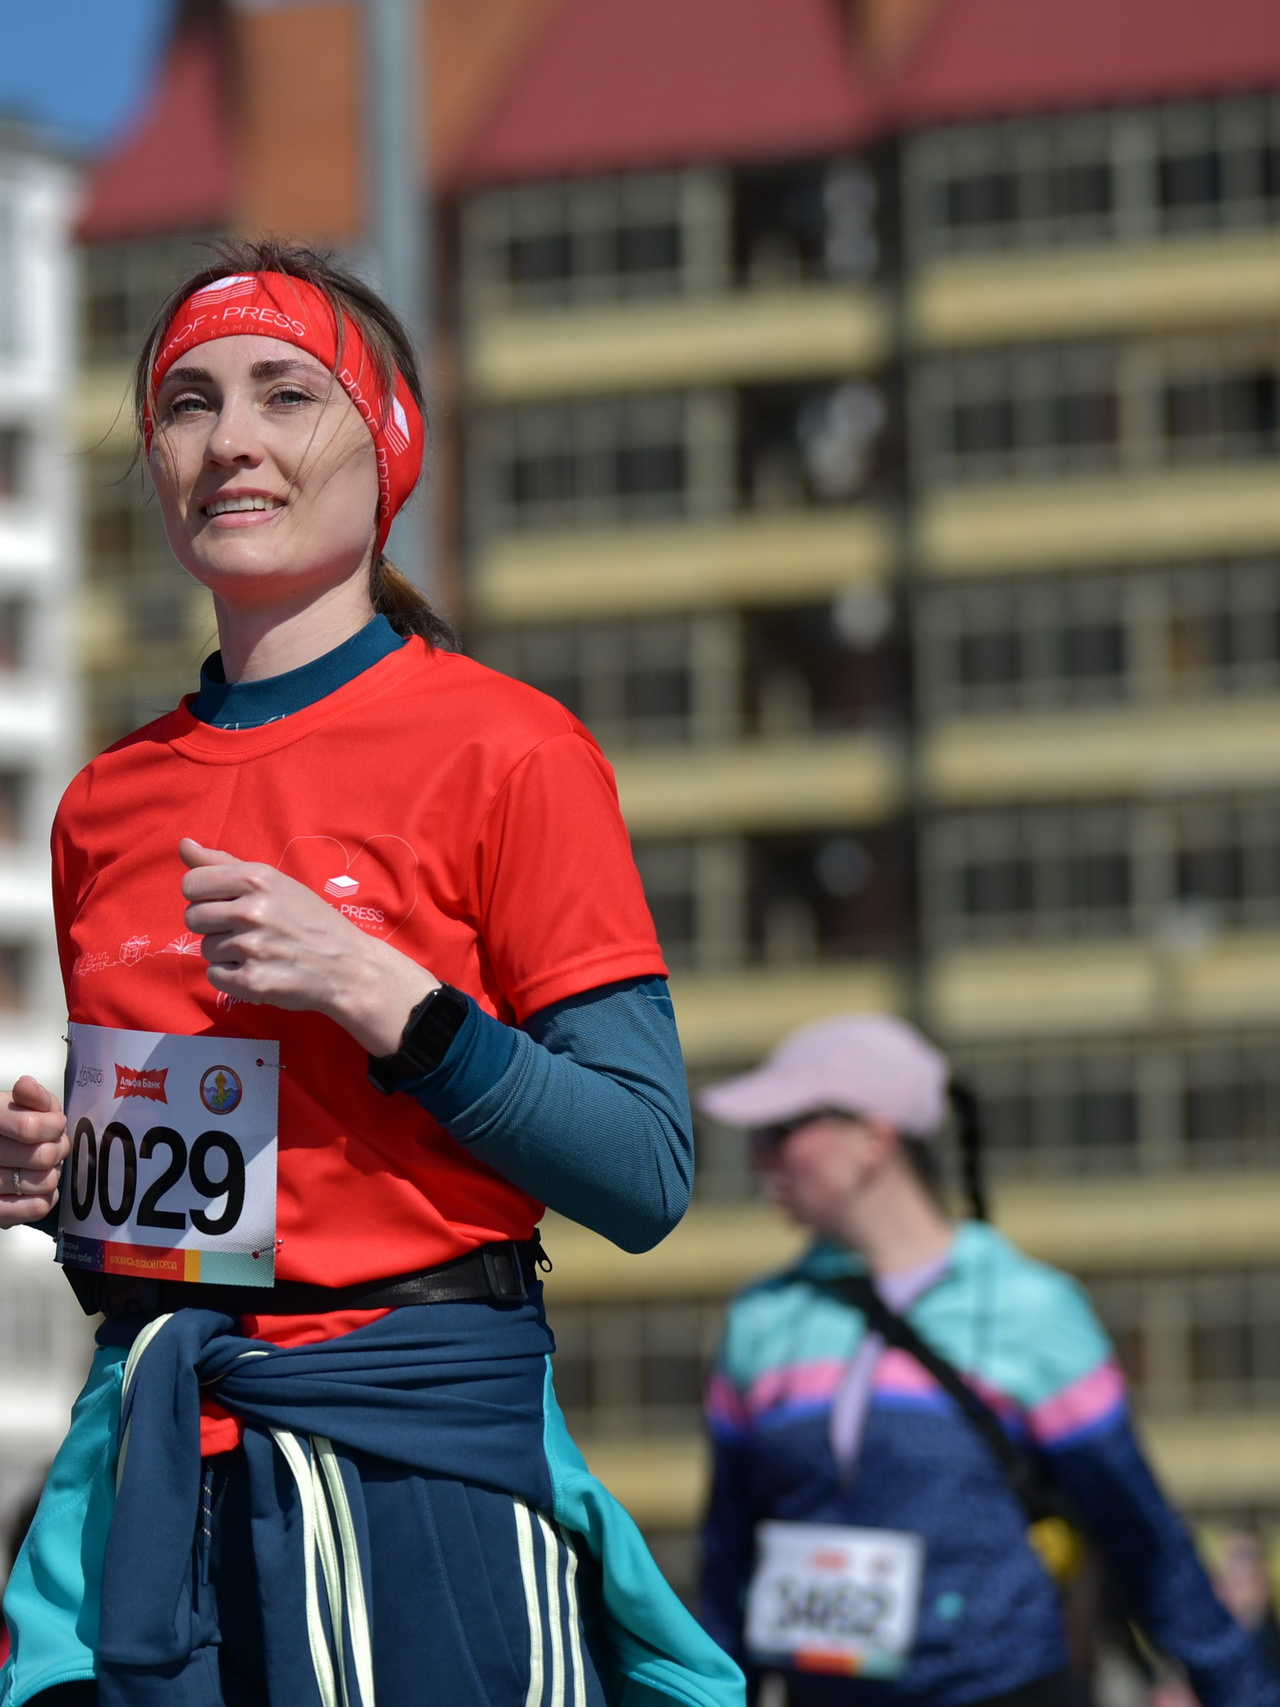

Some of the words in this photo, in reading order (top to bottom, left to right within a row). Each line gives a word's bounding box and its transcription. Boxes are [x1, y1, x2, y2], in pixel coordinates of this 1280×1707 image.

[223, 306, 306, 337] PRESS
[340, 904, 385, 923] PRESS
[120, 1076, 142, 1089] Альфа
[142, 1078, 161, 1089] Банк
[71, 1116, 245, 1236] 0029
